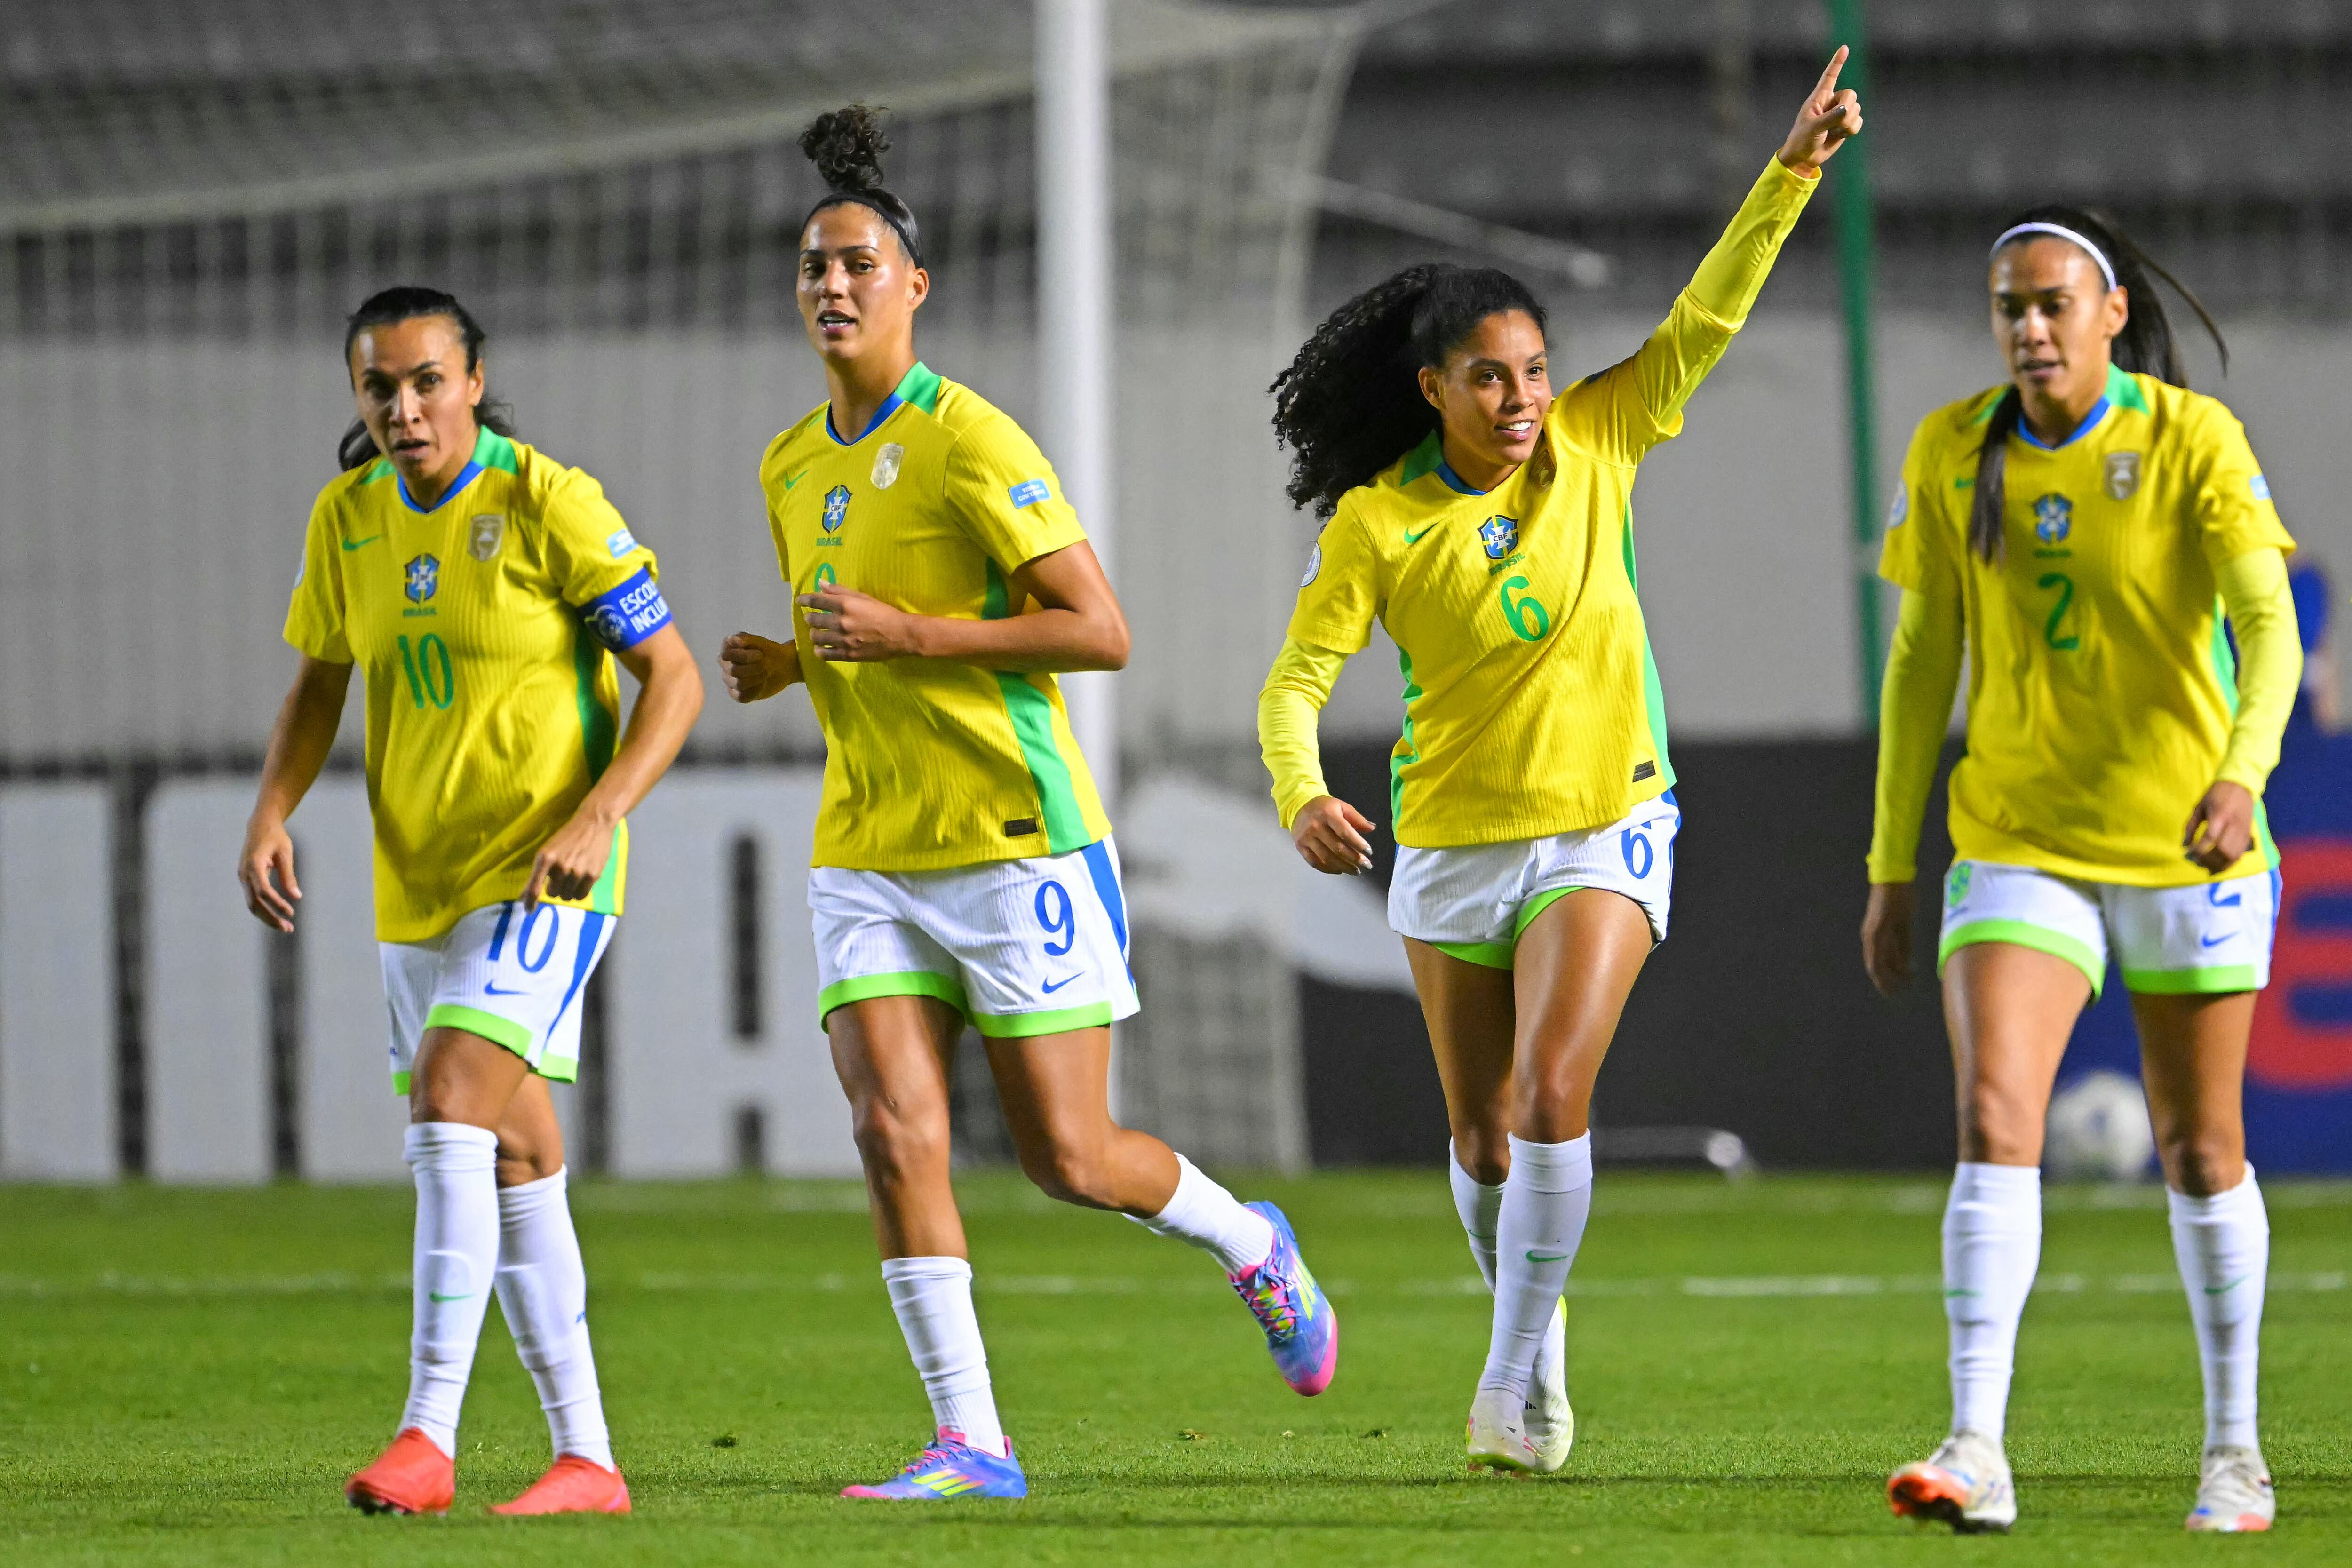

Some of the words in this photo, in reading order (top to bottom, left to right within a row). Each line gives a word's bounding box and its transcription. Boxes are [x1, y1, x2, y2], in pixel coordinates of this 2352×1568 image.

[816, 537, 843, 547] BRASIL
[1489, 552, 1526, 577] BRASIL
[1493, 533, 1508, 542] CBF
[1500, 575, 1549, 642] 6
[2038, 573, 2079, 651] 2
[397, 633, 454, 710] 10
[1621, 820, 1653, 879] 6
[487, 900, 559, 973] 10
[1035, 880, 1075, 956] 9
